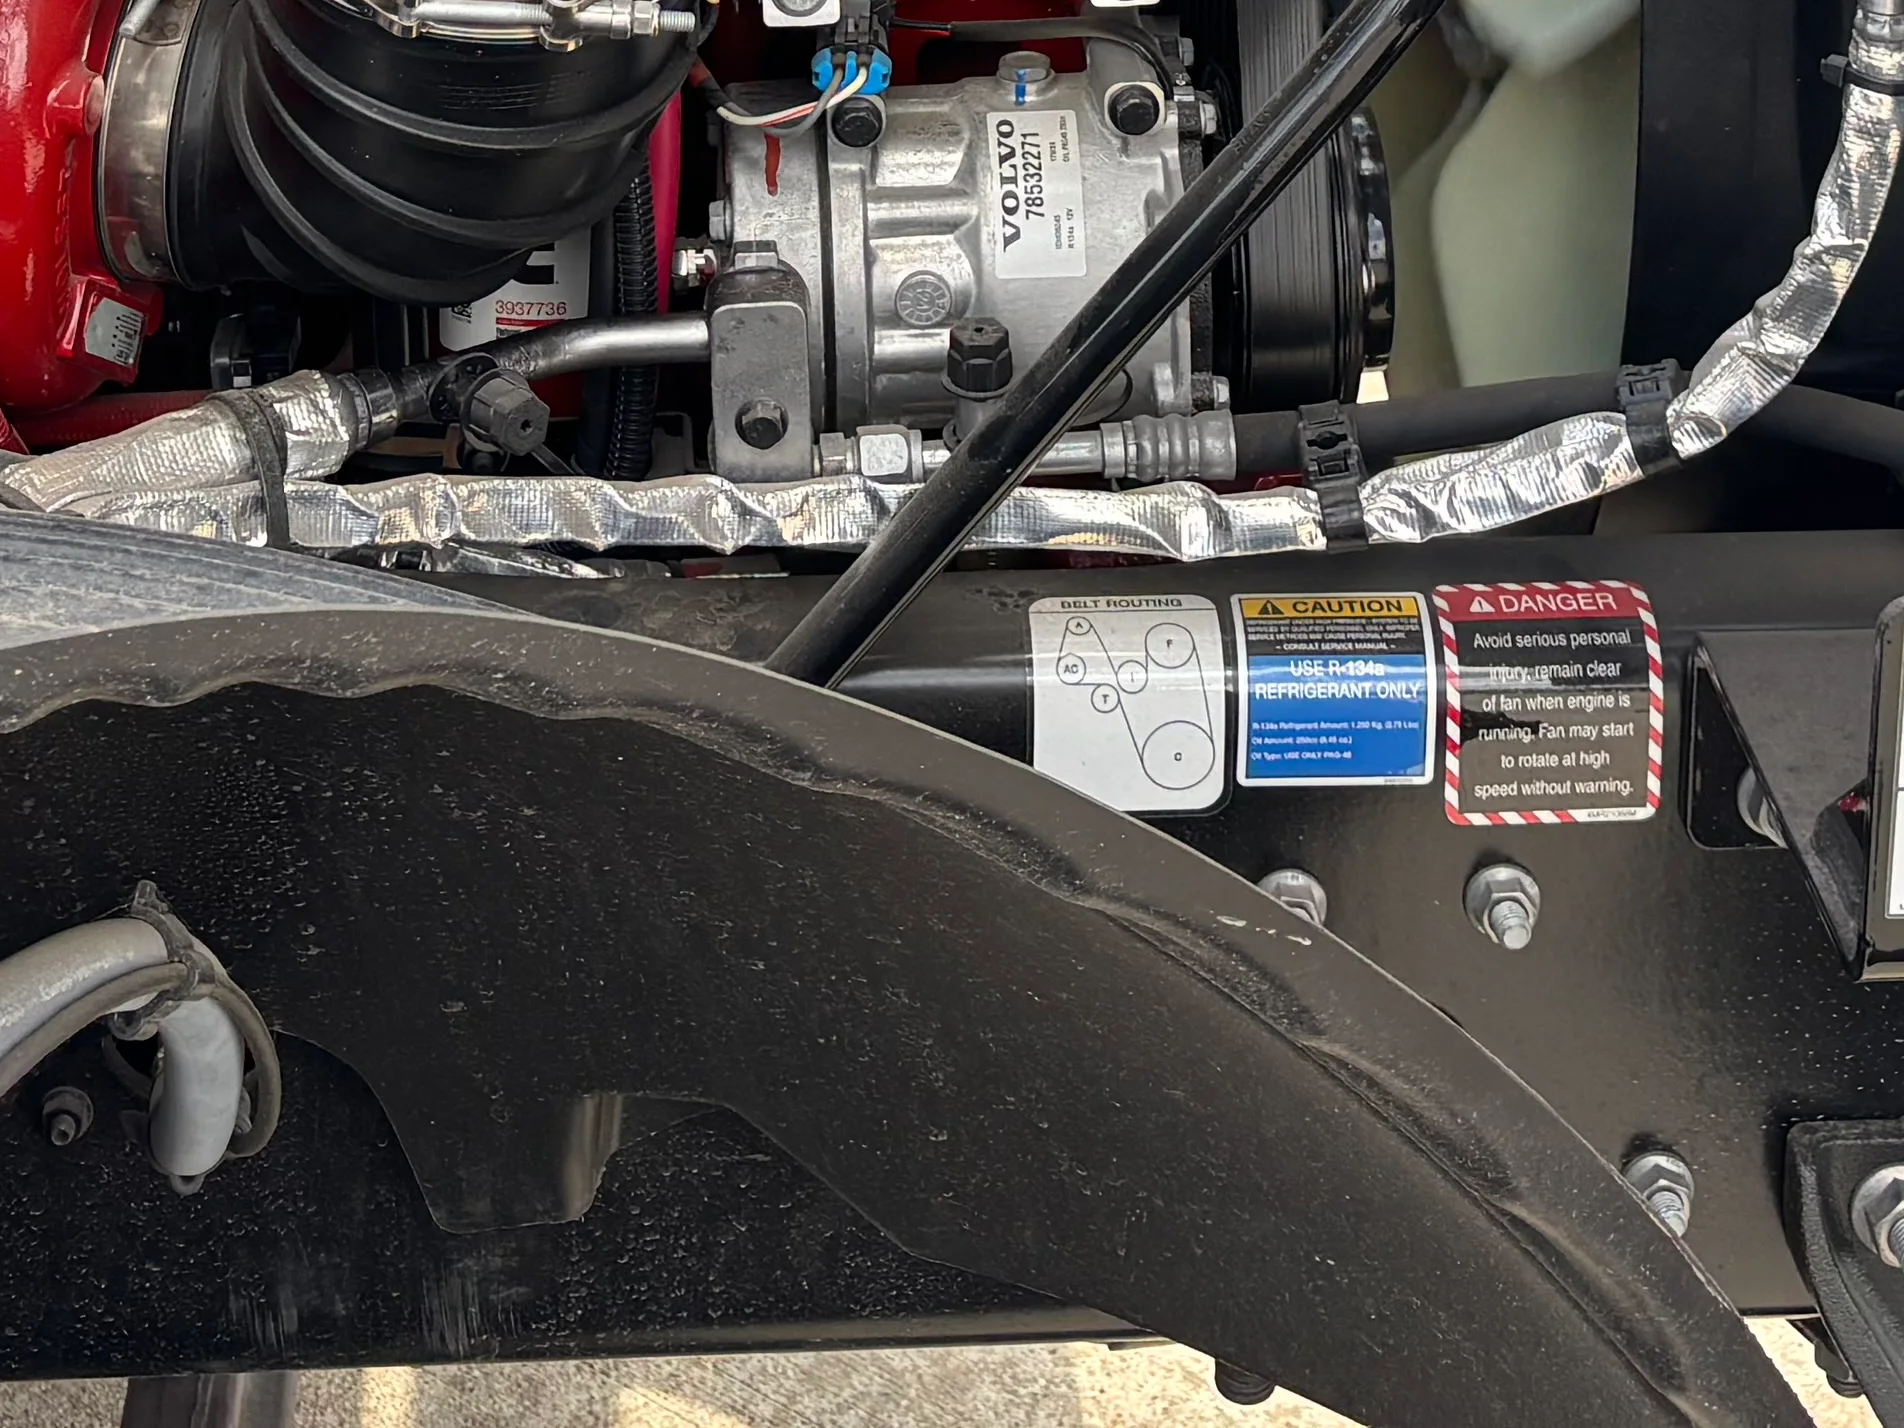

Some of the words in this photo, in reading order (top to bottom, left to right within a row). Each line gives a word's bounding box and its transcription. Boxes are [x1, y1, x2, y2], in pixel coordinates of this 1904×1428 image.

[1020, 132, 1045, 220] 78532271
[996, 119, 1021, 253] VOLVO
[496, 300, 567, 316] 3937736
[1061, 599, 1100, 609] BELT
[1106, 598, 1182, 608] ROUTING
[1292, 599, 1403, 614] CAUTION
[1498, 593, 1617, 613] DANGER
[1075, 621, 1084, 629] A
[1166, 639, 1173, 648] F
[1473, 632, 1512, 649] Avoid
[1516, 631, 1567, 647] serious
[1570, 629, 1632, 650] personal
[1063, 664, 1079, 674] AC
[1290, 660, 1324, 676] USE
[1329, 660, 1385, 676] R-134a
[1535, 664, 1584, 680] remain
[1586, 661, 1622, 677] clear
[1101, 694, 1110, 704] T
[1255, 683, 1373, 699] REFRIGERANT
[1376, 681, 1420, 698] ONLY
[1482, 697, 1497, 712] of
[1500, 695, 1522, 711] fan
[1525, 694, 1564, 710] when
[1567, 693, 1614, 714] engine
[1618, 692, 1631, 708] is
[1538, 723, 1566, 740] Fan
[1569, 725, 1599, 742] may
[1602, 722, 1635, 737] start
[1501, 755, 1515, 769] to
[1518, 753, 1559, 767] rotate
[1562, 752, 1577, 766] at
[1580, 750, 1611, 769] high
[1474, 781, 1518, 800] speed
[1520, 779, 1572, 796] without
[1575, 778, 1635, 796] warning.
